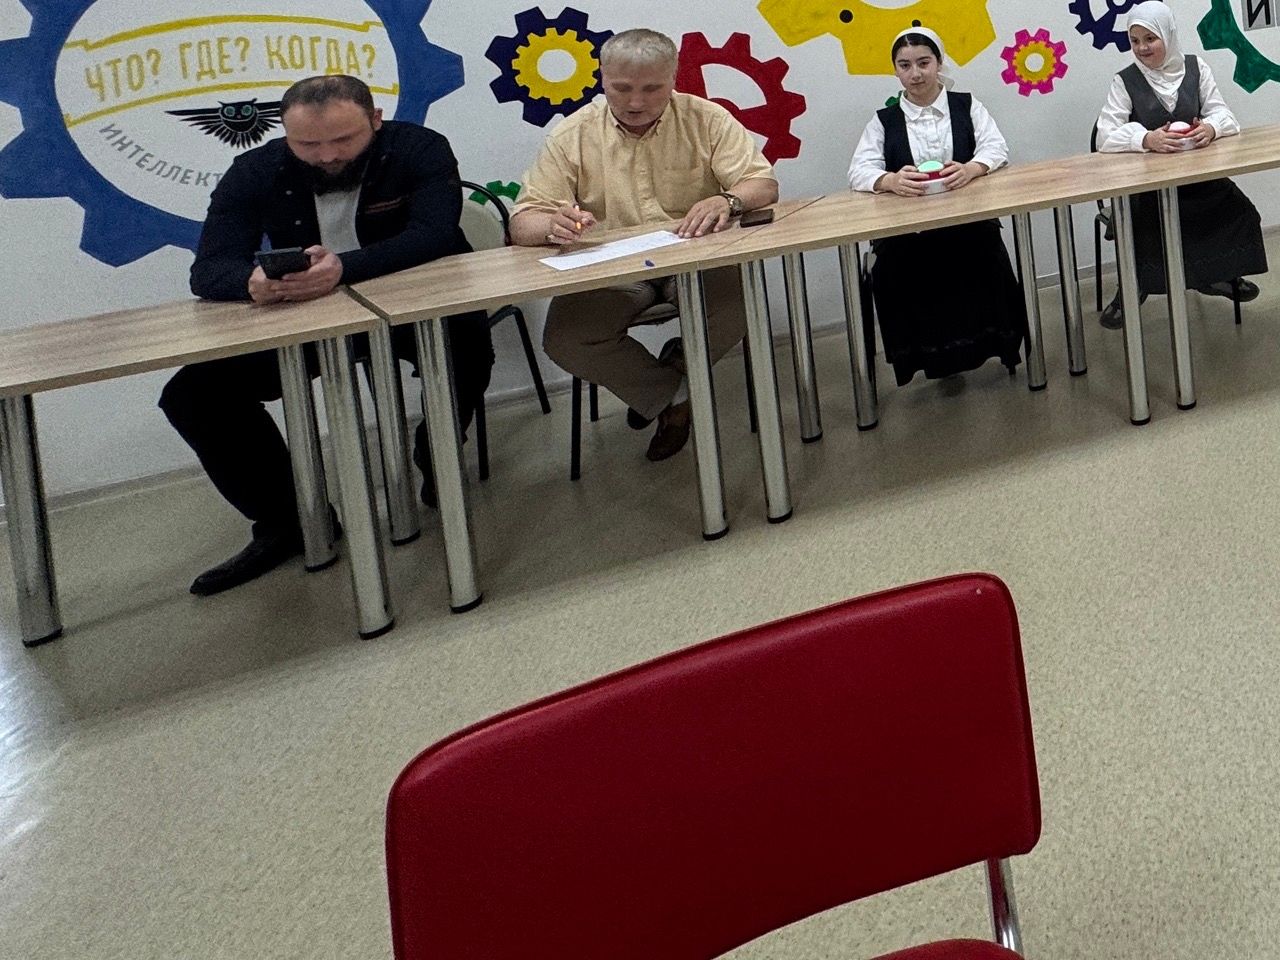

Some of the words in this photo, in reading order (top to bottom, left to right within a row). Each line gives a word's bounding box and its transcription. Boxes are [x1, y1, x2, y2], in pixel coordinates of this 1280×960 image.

[85, 48, 162, 102] ЧТО?
[179, 37, 250, 81] ГДЕ?
[265, 35, 377, 78] КОГДА?
